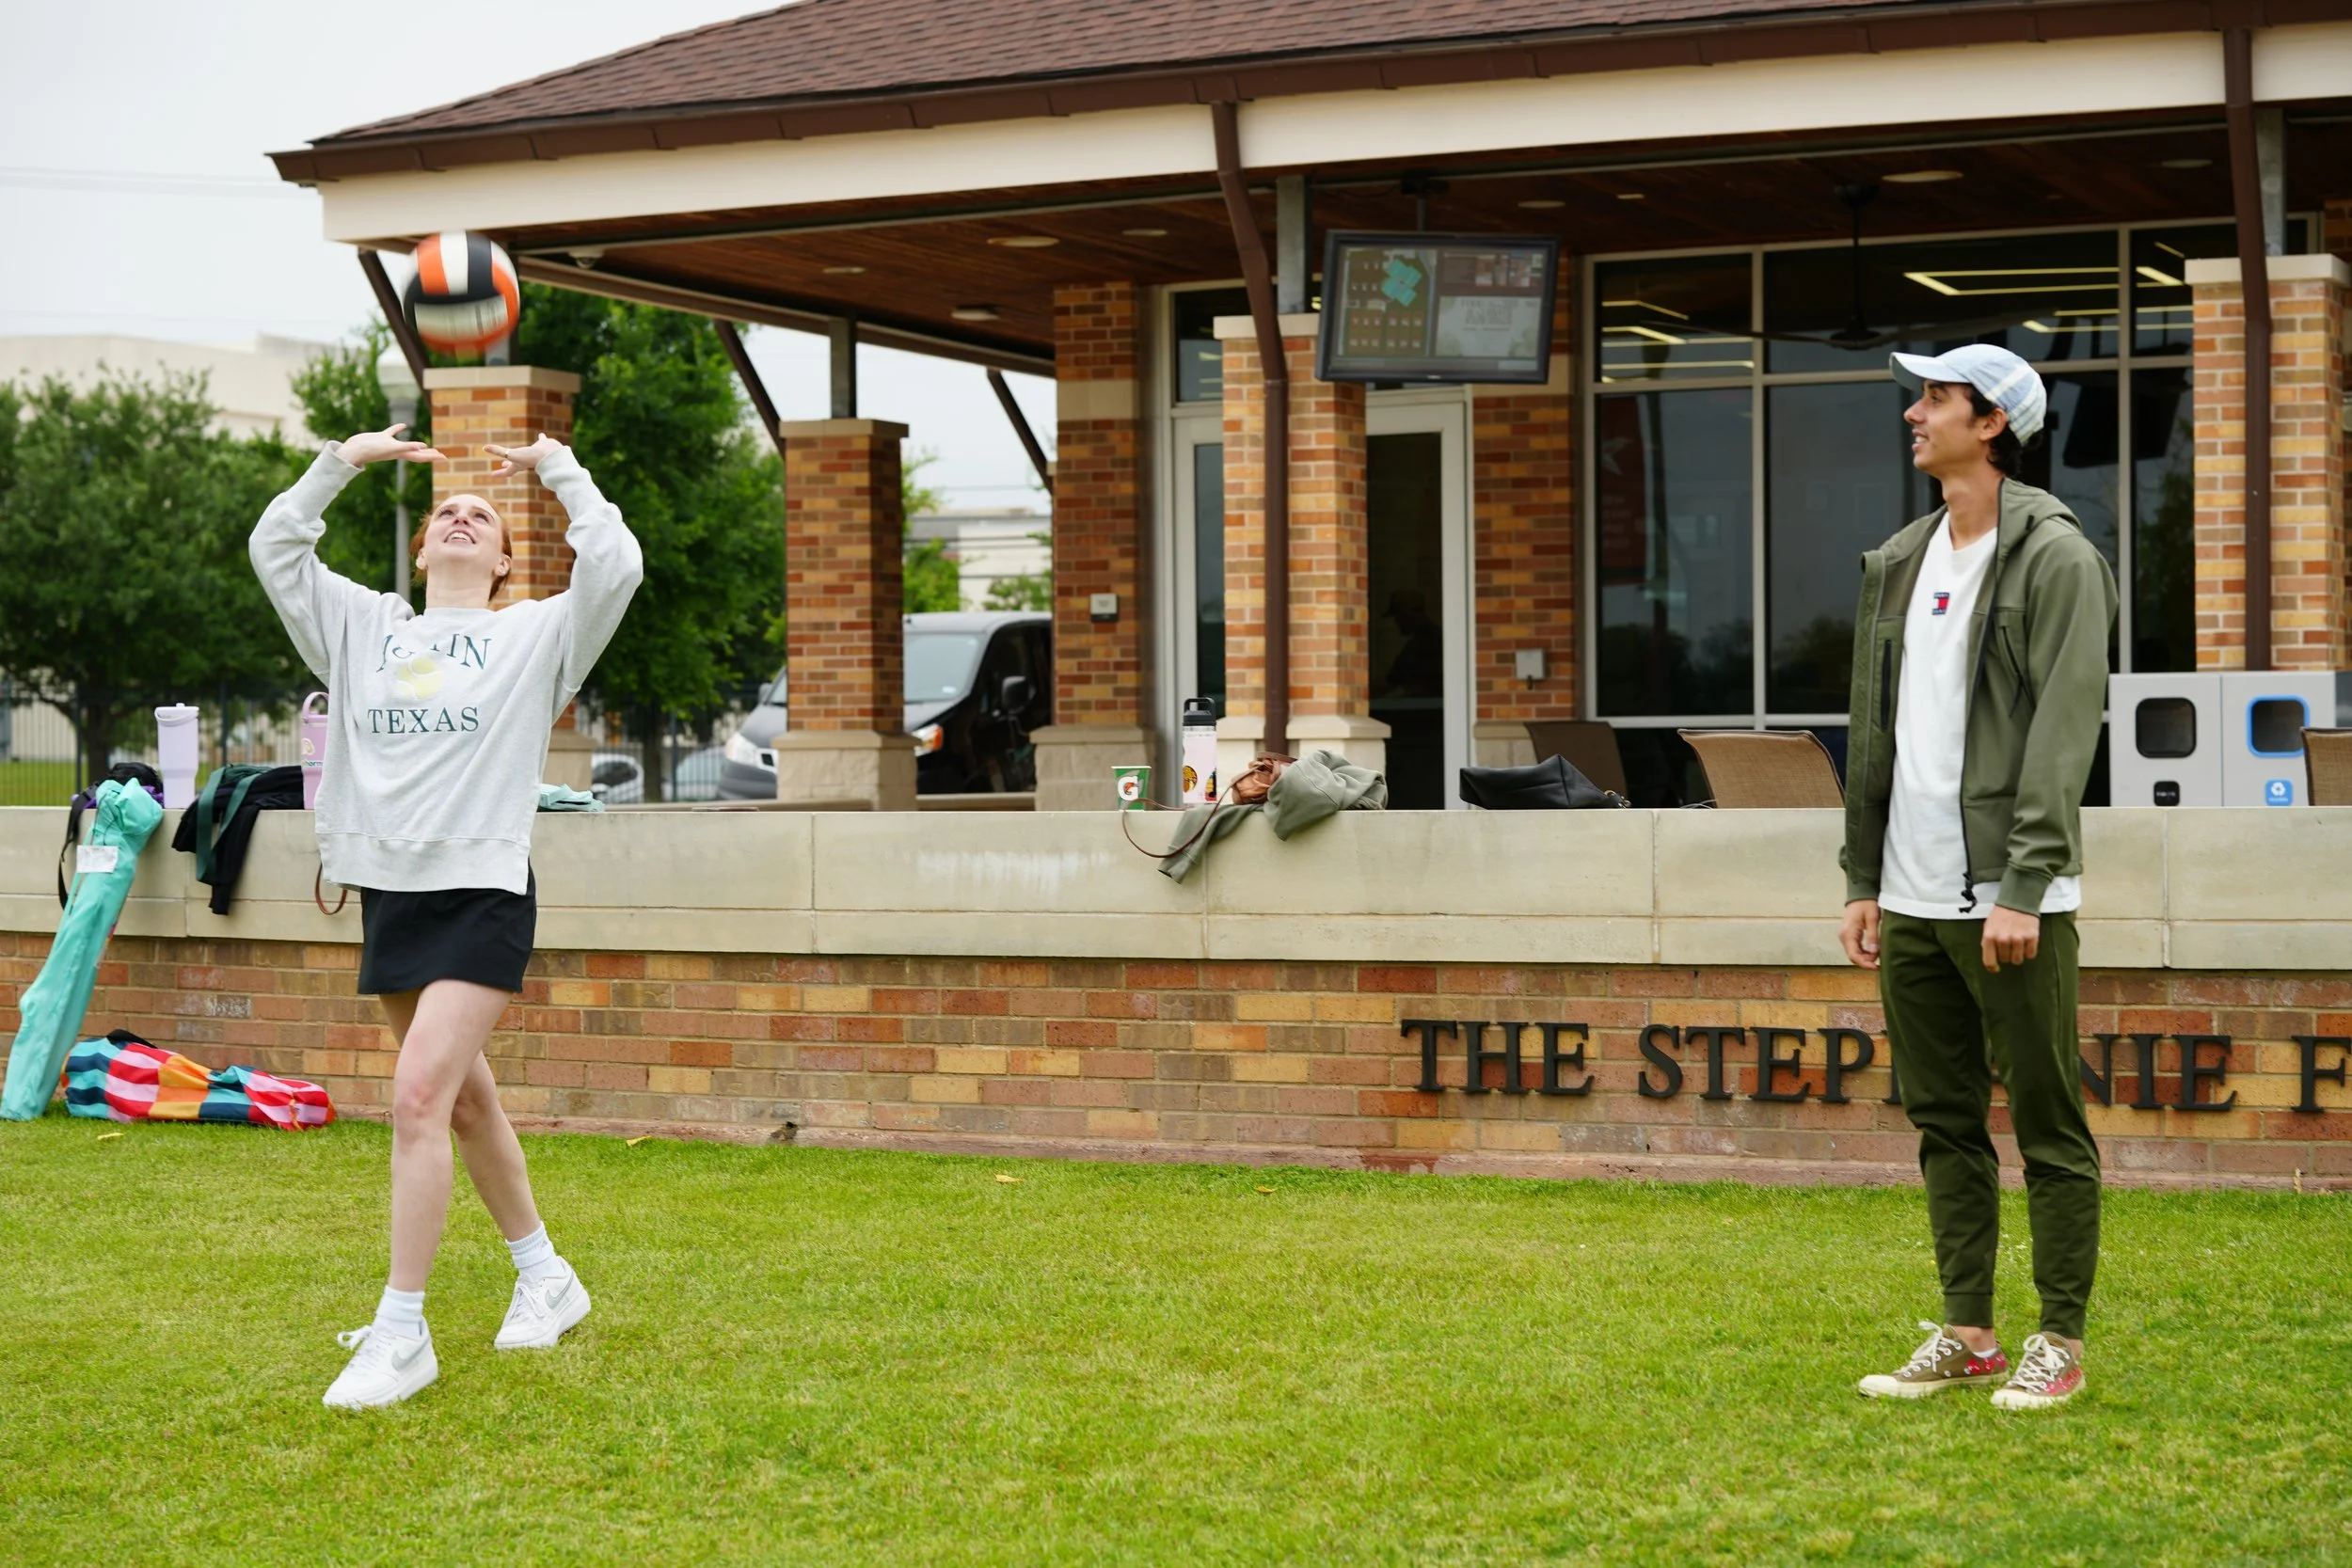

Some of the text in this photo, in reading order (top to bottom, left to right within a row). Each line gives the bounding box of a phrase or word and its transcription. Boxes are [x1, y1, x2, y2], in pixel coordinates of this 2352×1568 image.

[367, 706, 479, 734] TEXAS
[1401, 1019, 2352, 1113] THE STEPNIE F
